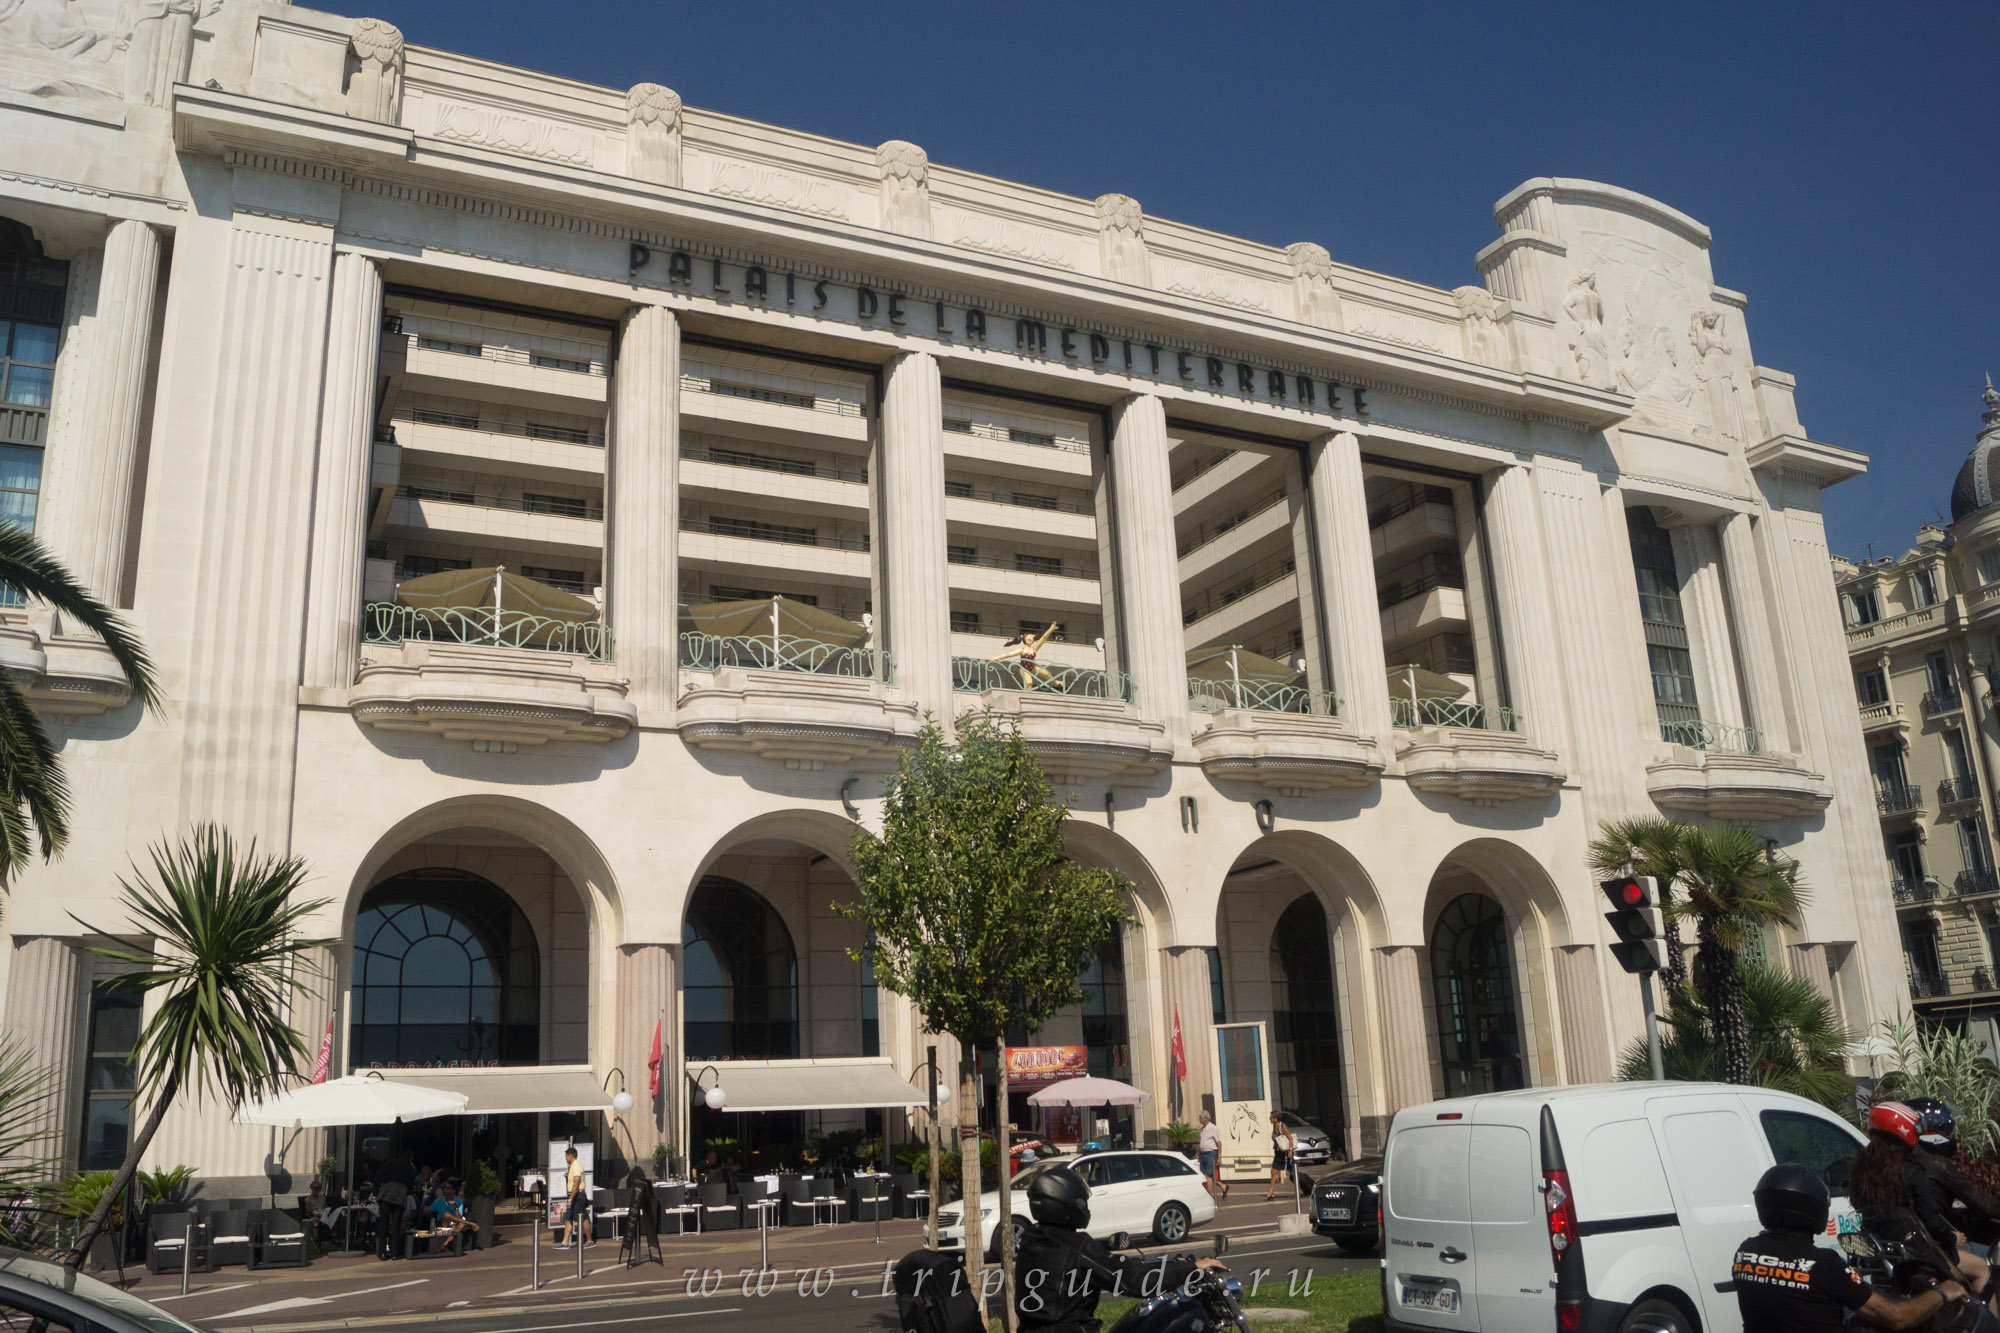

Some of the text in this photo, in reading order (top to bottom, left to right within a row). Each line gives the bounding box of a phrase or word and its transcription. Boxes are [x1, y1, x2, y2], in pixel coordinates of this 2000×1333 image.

[629, 243, 1371, 416] PALAIS DE LA MEDITERRANEE
[1733, 1263, 1811, 1283] RACING
[1734, 1272, 1810, 1290] official team
